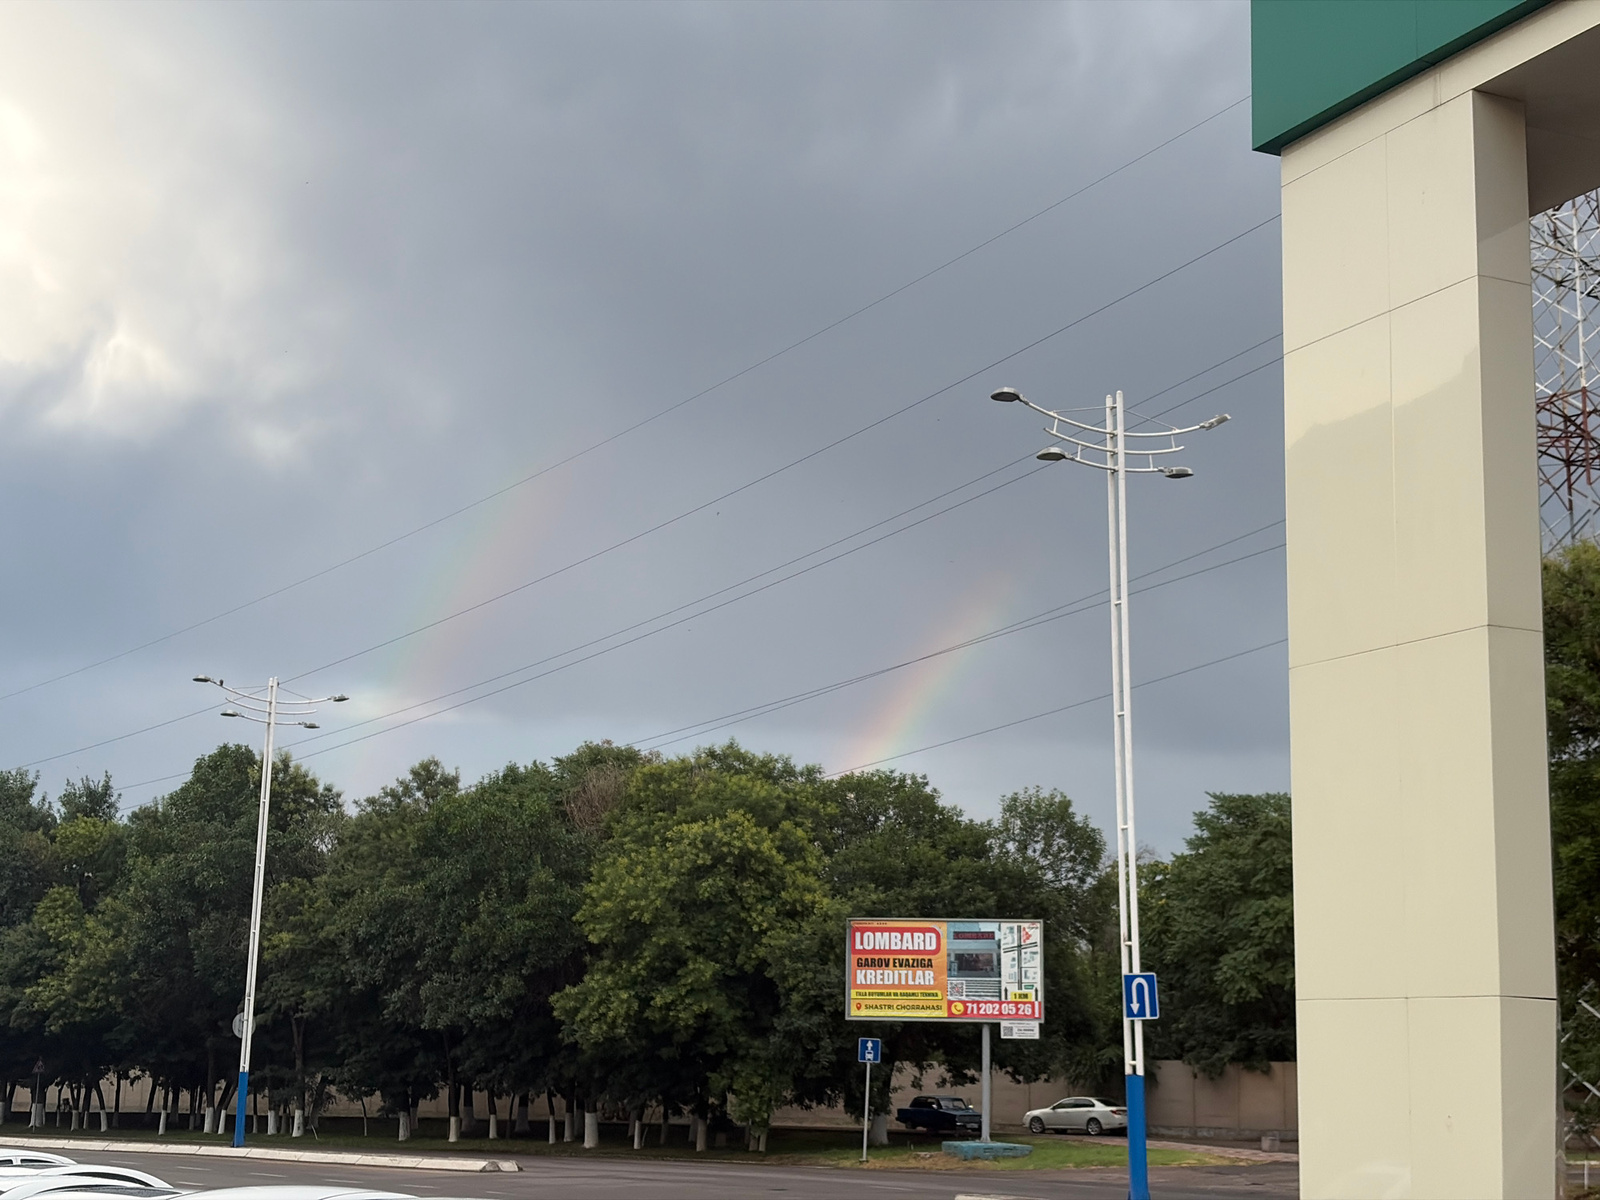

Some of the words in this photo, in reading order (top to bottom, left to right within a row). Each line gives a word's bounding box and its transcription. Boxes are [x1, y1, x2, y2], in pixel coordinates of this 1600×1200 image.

[855, 932, 936, 950] LOMBARD
[857, 957, 890, 968] GAROV
[893, 958, 933, 968] EVAZIGA
[856, 969, 934, 985] KREDITLAR
[864, 1003, 894, 1011] SHASTRI
[966, 1003, 977, 1014] 71
[979, 1003, 999, 1015] 202
[1001, 1003, 1016, 1015] 05
[1018, 1004, 1032, 1016] 26
